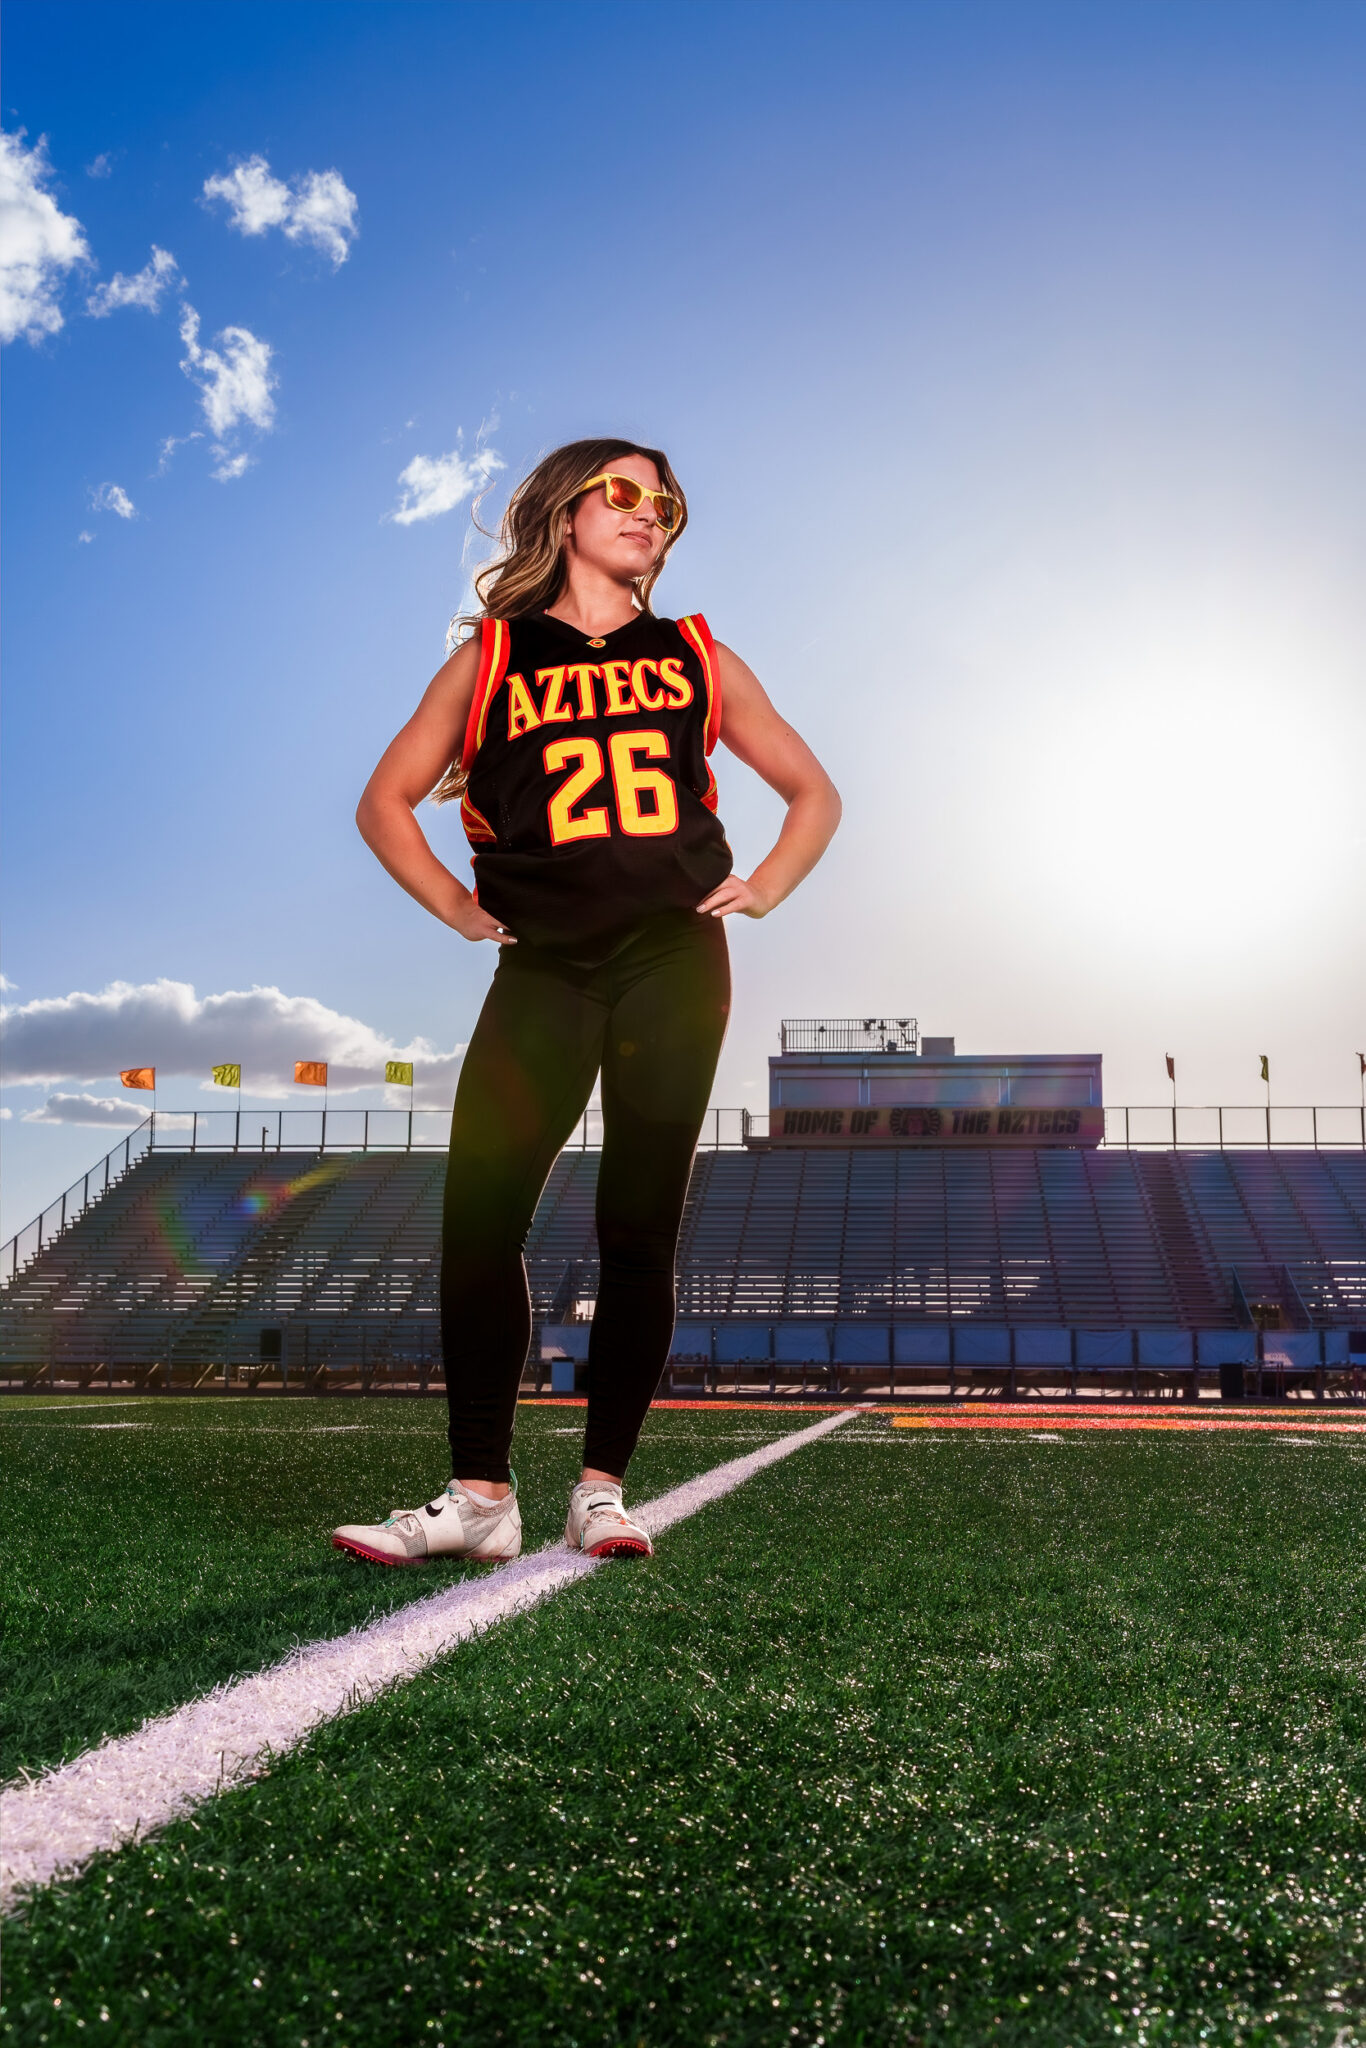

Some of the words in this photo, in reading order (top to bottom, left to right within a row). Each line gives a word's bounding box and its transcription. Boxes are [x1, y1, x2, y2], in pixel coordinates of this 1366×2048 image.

[506, 658, 694, 741] AZTECS
[543, 729, 679, 847] 26
[783, 1110, 844, 1135] HOME
[850, 1110, 879, 1135] OF
[951, 1109, 991, 1135] THE
[998, 1109, 1081, 1134] AZTECS
